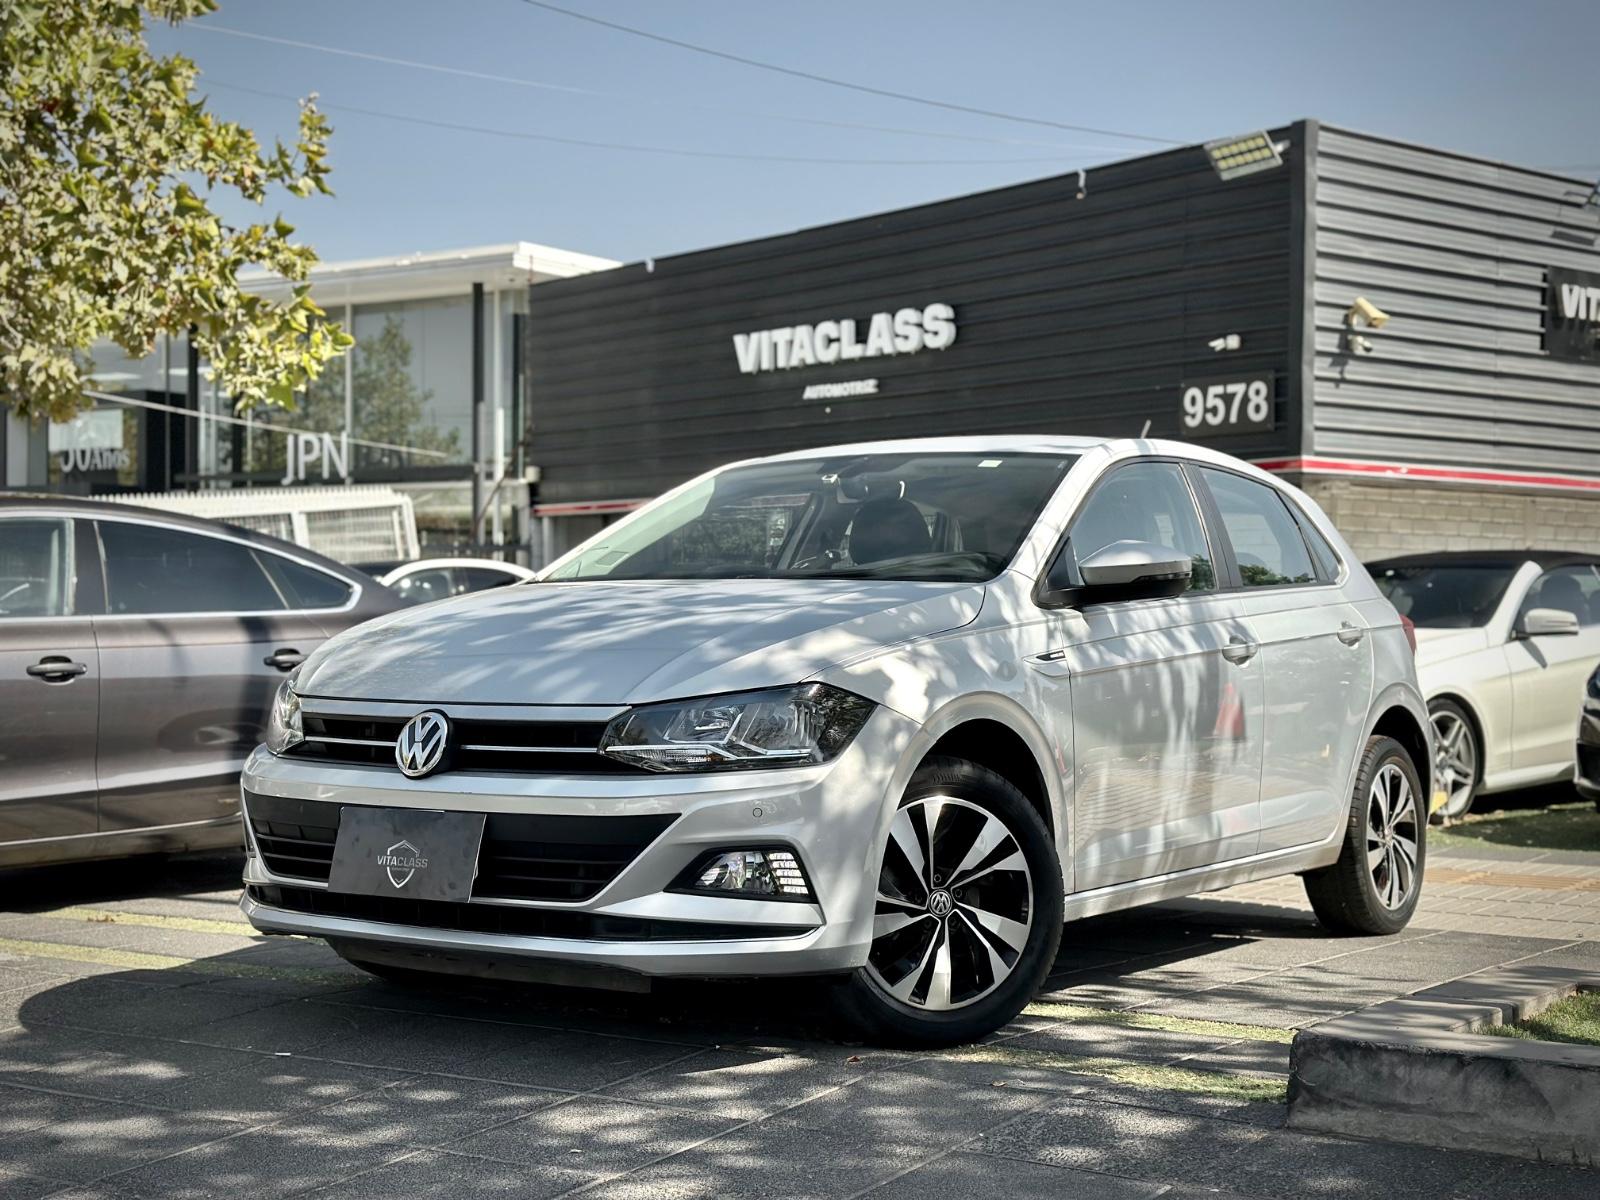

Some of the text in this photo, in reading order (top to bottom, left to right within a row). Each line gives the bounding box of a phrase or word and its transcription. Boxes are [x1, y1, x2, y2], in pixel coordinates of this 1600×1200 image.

[1562, 283, 1600, 321] VIT
[733, 303, 957, 373] VITACLASS
[1183, 380, 1269, 428] 9578
[281, 431, 347, 486] JPN
[396, 711, 449, 777] VW
[377, 855, 429, 868] VITACLASS
